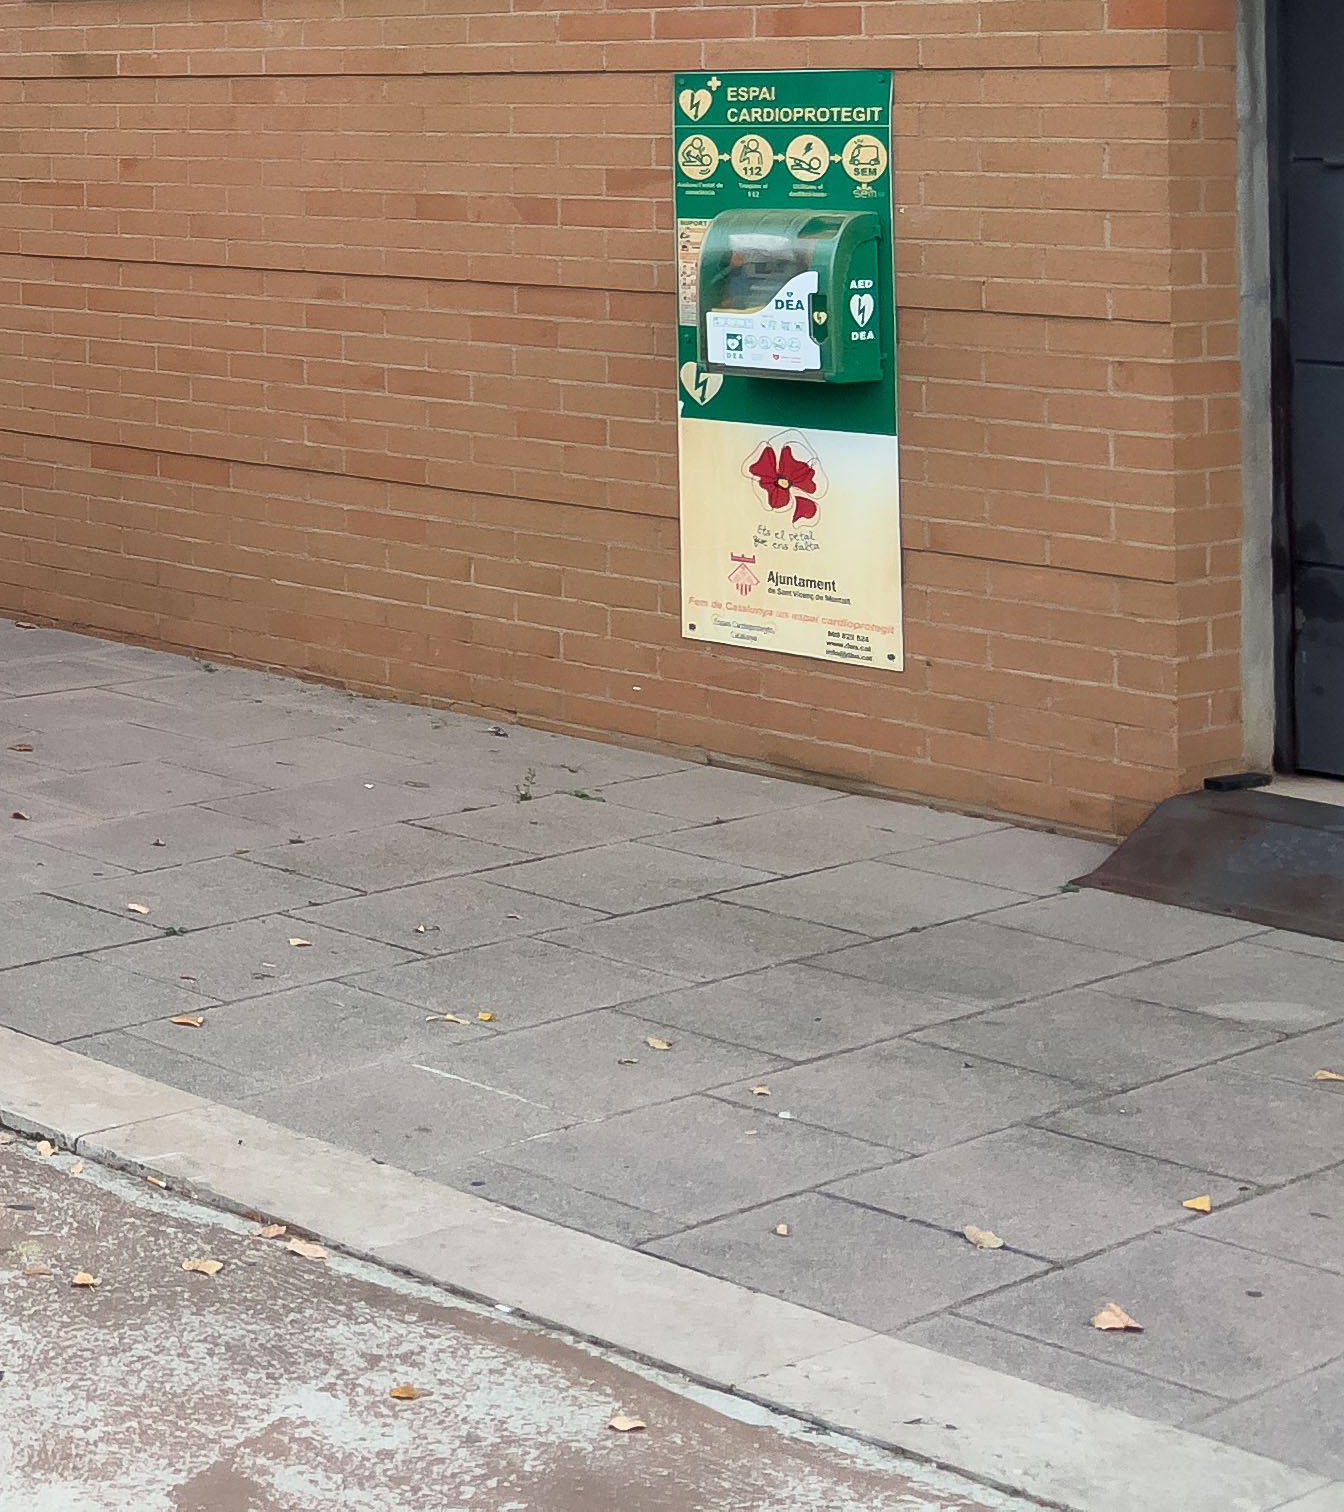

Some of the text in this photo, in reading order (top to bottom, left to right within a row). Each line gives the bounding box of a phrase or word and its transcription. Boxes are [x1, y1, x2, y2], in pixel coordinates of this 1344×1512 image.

[726, 86, 776, 102] ESPAI
[726, 106, 883, 123] CARDIOPROTEGIT
[742, 166, 762, 176] 112
[853, 167, 877, 177] SEM
[849, 279, 874, 290] AED
[774, 299, 805, 311] DEA
[851, 331, 875, 341] DEA
[767, 570, 837, 593] Ajuntament
